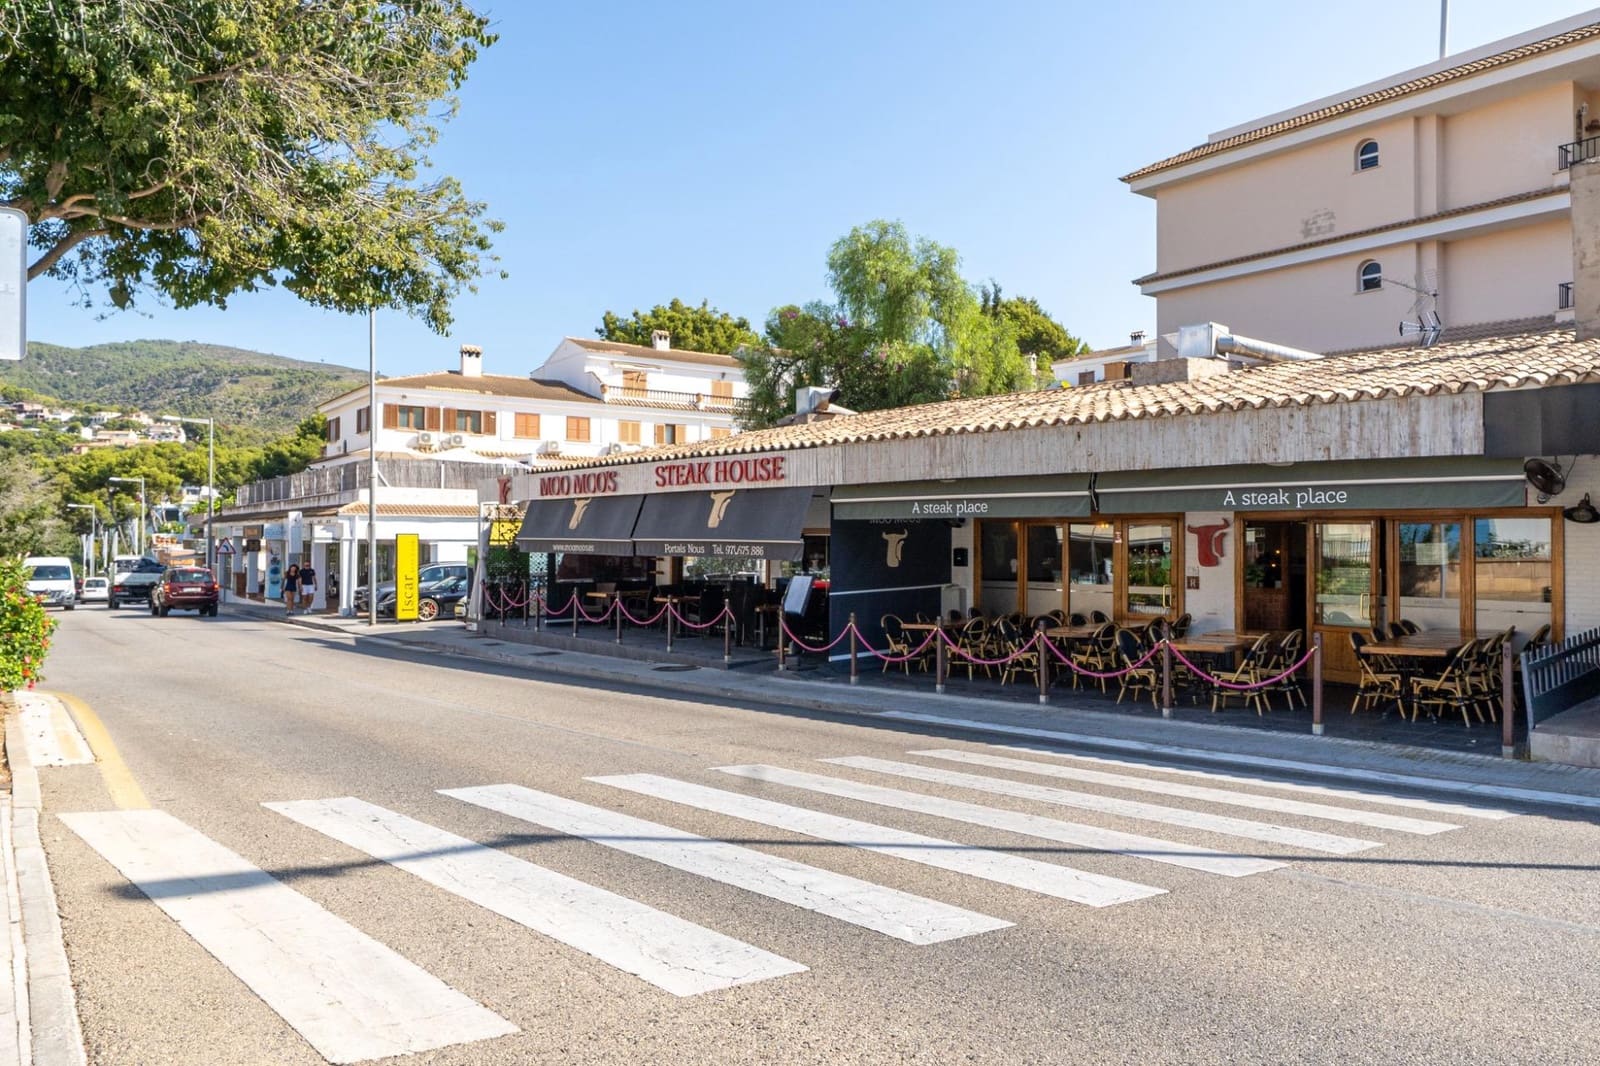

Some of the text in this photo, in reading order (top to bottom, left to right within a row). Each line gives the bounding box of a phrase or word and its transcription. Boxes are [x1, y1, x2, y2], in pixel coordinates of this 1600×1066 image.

[655, 456, 785, 487] STEAK HOUSE
[540, 471, 618, 496] MOO MOO'S
[911, 500, 989, 517] A steak place
[1223, 487, 1348, 509] A steak place
[664, 543, 687, 554] Portals
[687, 543, 705, 554] Nous
[401, 574, 415, 612] Iscar
